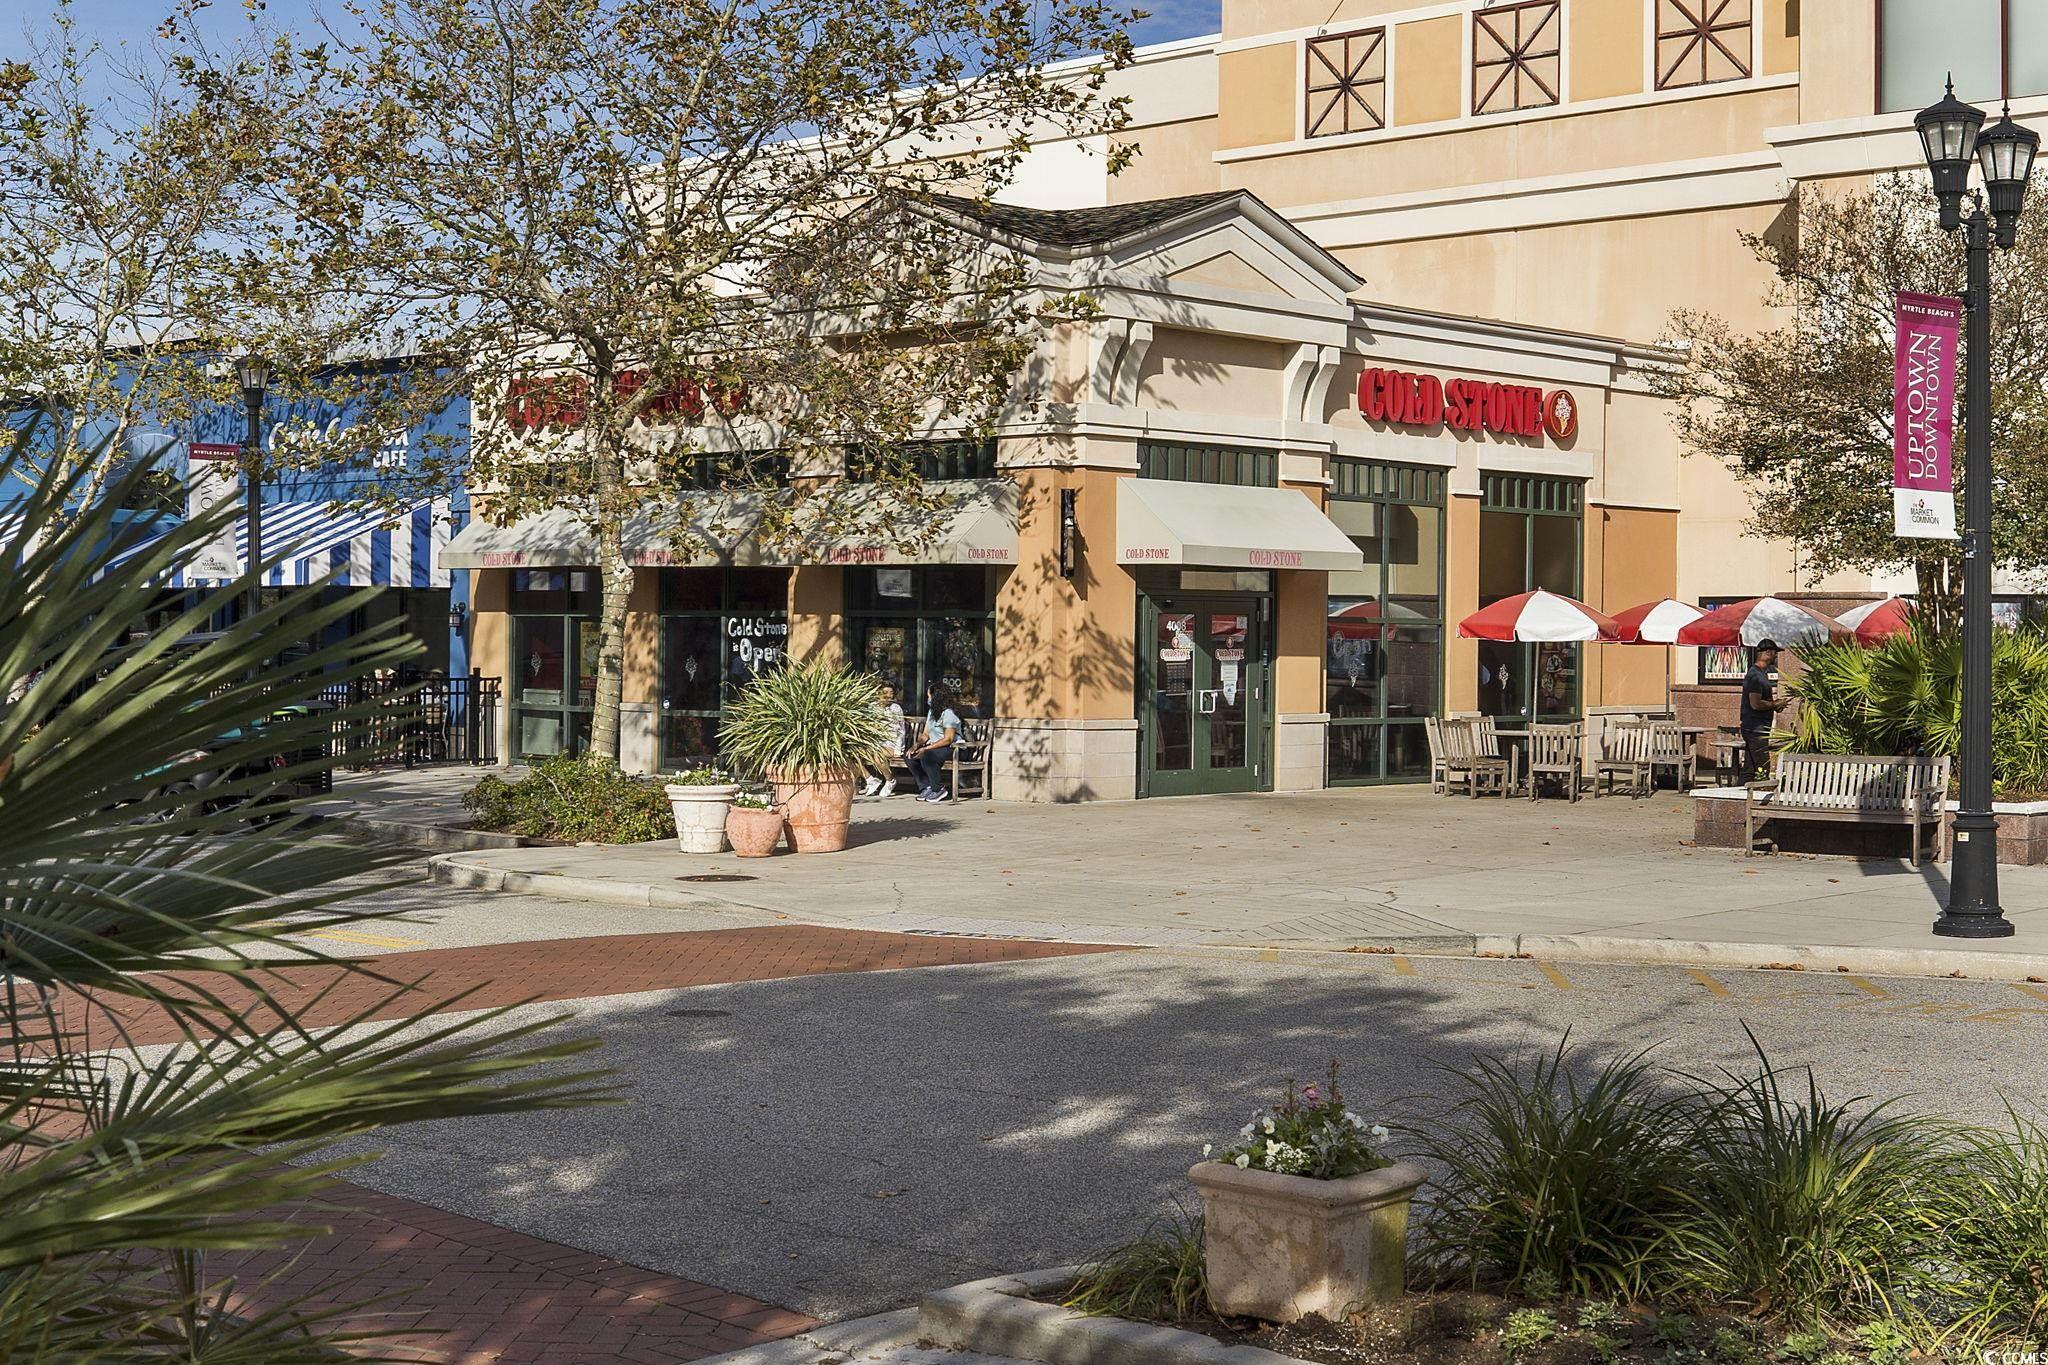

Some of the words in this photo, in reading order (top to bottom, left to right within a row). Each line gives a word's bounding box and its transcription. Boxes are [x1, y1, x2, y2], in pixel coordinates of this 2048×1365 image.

[1902, 304, 1926, 315] MYRTLE
[1928, 306, 1955, 318] BEACH'S
[1358, 368, 1444, 425] COLD
[1444, 378, 1543, 437] STONE
[1907, 330, 1928, 480] UPTOWN
[1925, 334, 1943, 480] DOWNTOWN
[1910, 507, 1934, 517] MARKET
[1912, 515, 1940, 526] COMMON
[483, 552, 500, 567] COLD
[502, 551, 526, 566] STONE
[633, 550, 655, 565] COLD
[828, 548, 850, 563] COLD
[850, 548, 886, 562] STONE
[968, 548, 985, 559] COLD
[986, 549, 1009, 560] STONE
[1125, 548, 1144, 559] COLD
[1145, 548, 1169, 559] STONE
[1249, 550, 1273, 566] COLD
[1273, 551, 1302, 567] STONE
[728, 617, 753, 637] Cold
[754, 617, 787, 637] Stone
[732, 642, 739, 652] is
